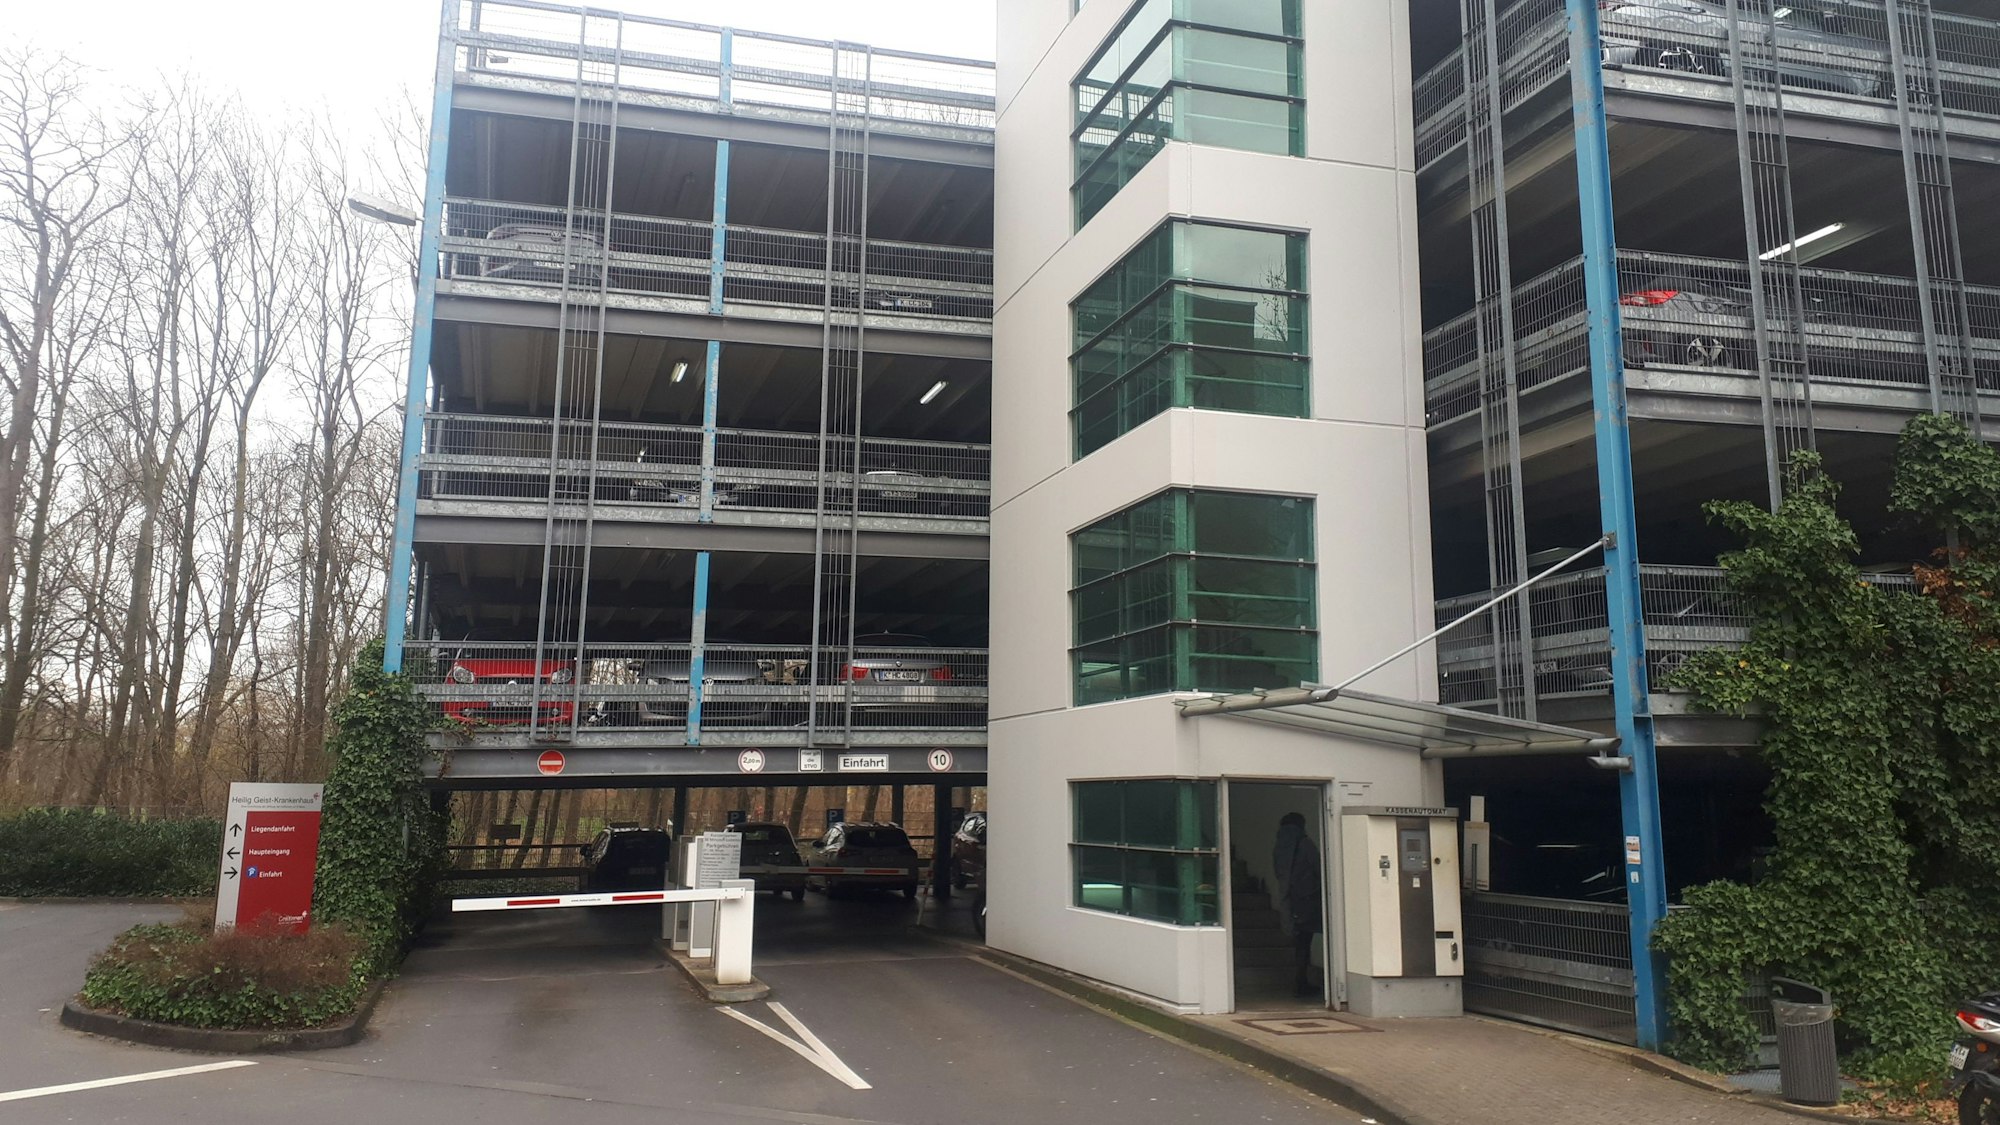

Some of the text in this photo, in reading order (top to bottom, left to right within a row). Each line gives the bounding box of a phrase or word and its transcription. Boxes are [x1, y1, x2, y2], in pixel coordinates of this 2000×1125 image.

[843, 758, 885, 768] Einfahrt
[934, 755, 946, 765] 10
[232, 796, 252, 805] Heilig
[1385, 807, 1447, 815] KASSENAUTOMAT
[251, 825, 295, 833] Liegendanfahrt
[249, 848, 291, 856] Haupteingang
[259, 870, 283, 878] Einfahrt
